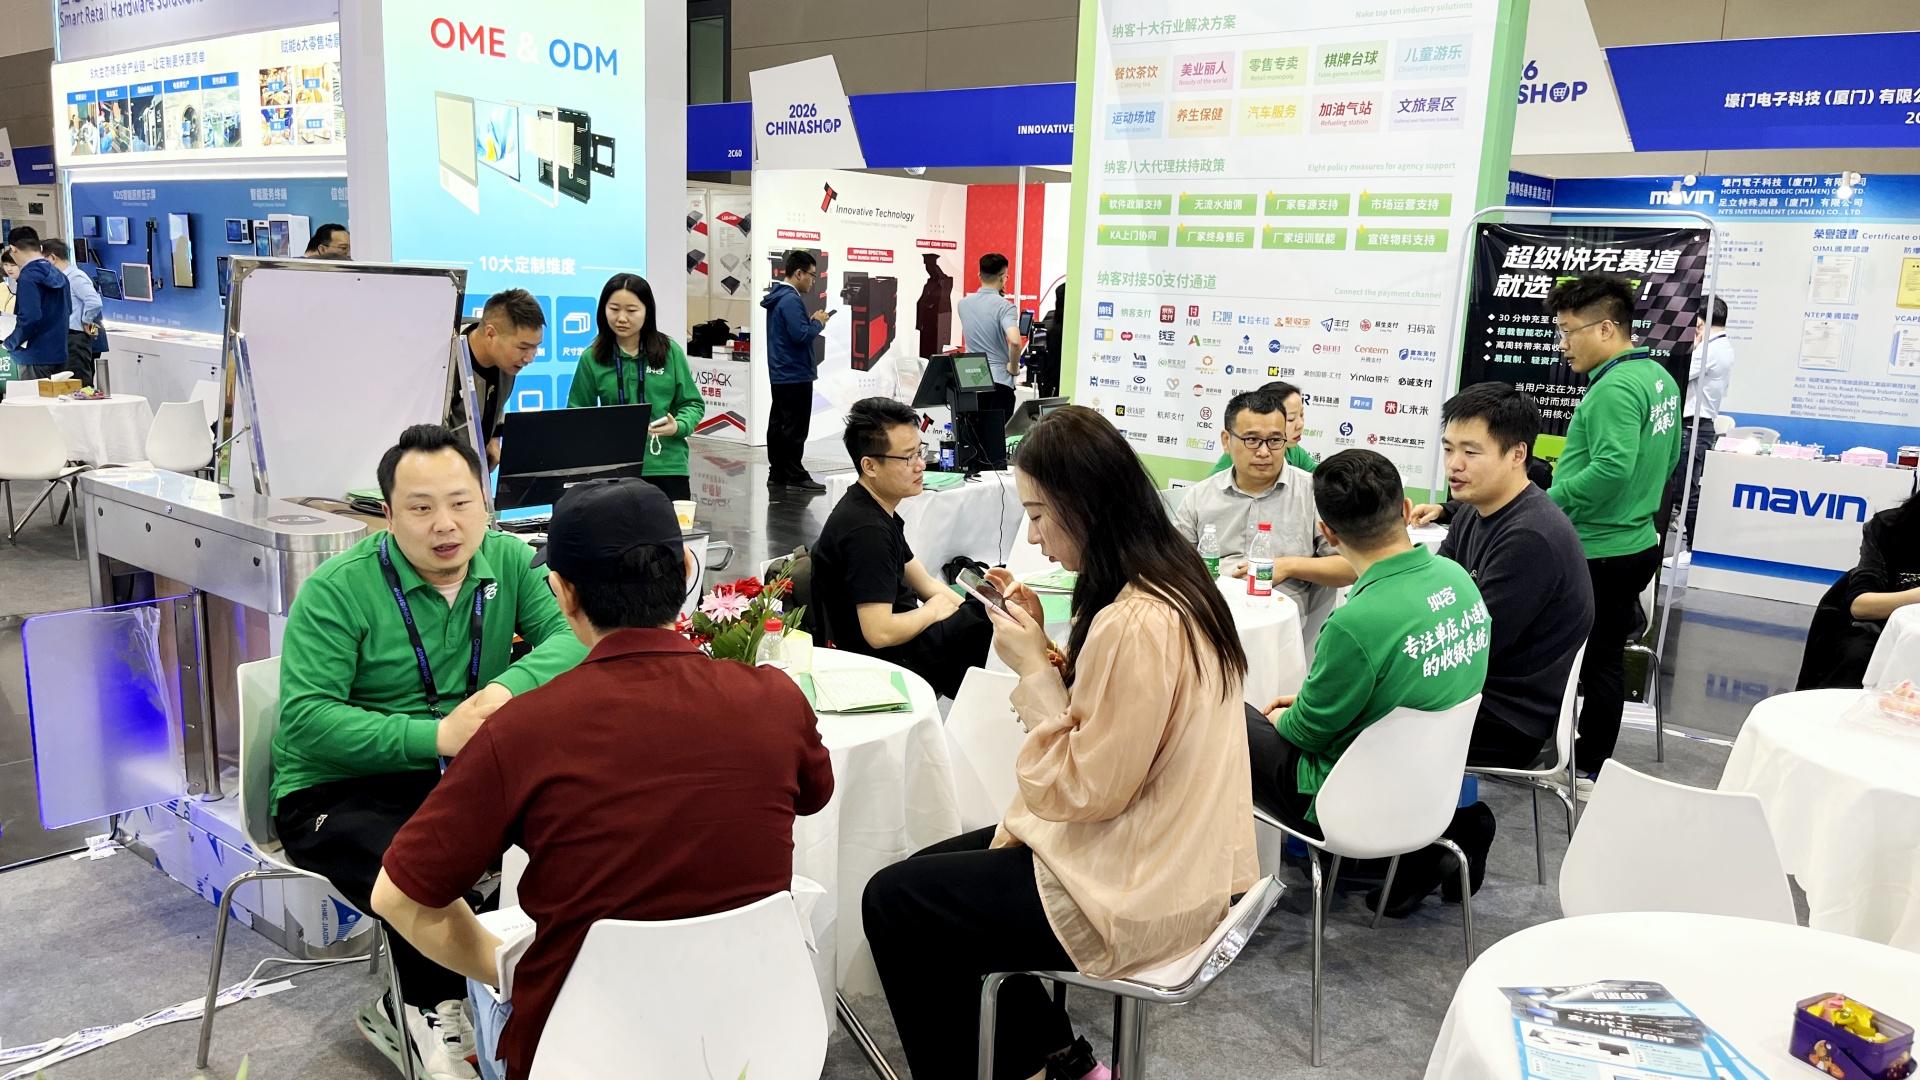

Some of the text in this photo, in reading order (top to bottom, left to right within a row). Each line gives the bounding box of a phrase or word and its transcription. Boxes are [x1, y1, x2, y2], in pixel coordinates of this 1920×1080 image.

[60, 9, 84, 28] Smart
[86, 3, 109, 23] Retail
[1403, 5, 1435, 15] industry
[1436, 2, 1473, 12] solutions
[1112, 14, 1237, 39] 纳客十大行业解决方案
[430, 17, 506, 58] OME
[549, 38, 618, 76] ODM
[1405, 45, 1463, 63] 儿童游乐
[1249, 56, 1298, 72] 零售专卖
[1324, 50, 1379, 68] 棋牌台球
[1114, 65, 1159, 81] 餐饮茶饮
[1180, 61, 1227, 77] 美业丽人
[788, 103, 817, 119] 2026
[1248, 105, 1297, 119] 汽车服务
[1319, 100, 1373, 117] 加油气站
[1397, 96, 1457, 114] 文旅景区
[1112, 111, 1156, 125] 运动场馆
[1176, 107, 1224, 122] 养生保健
[765, 118, 842, 136] CHINASHOP
[1017, 124, 1074, 135] INNOVATIVE
[728, 149, 742, 158] 2C60
[1104, 158, 1226, 174] 纳客八大代理扶持政策
[1307, 164, 1326, 173] Eight
[1327, 163, 1348, 172] policy
[1397, 163, 1424, 172] agency
[1425, 162, 1456, 170] support
[1371, 198, 1439, 211] 市场运营支持
[1649, 190, 1715, 206] mvin
[835, 204, 915, 222] Innovative Technology
[1734, 208, 1786, 216] INSTRUMENT
[796, 231, 820, 240] SPECTRAL
[1273, 232, 1336, 245] 厂家培训赋能
[1368, 233, 1436, 246] 宣传物料支持
[1862, 233, 1910, 241] Certificate
[479, 255, 577, 276] 10大定制维度
[1501, 244, 1683, 274] 超级快充赛道
[1097, 270, 1217, 290] 纳客对接50支付通道
[1334, 287, 1363, 296] Connect
[1411, 290, 1442, 298] channel
[1498, 314, 1550, 325] 30 分钟充至
[1407, 323, 1436, 335] 扫码富
[1354, 344, 1389, 355] Centerm
[1495, 340, 1565, 352] 高周转带来高收
[1650, 349, 1671, 357] 35%
[691, 370, 733, 387] ASPACK
[1398, 377, 1433, 388] 必诚支付
[701, 386, 722, 398] 乐思百
[1398, 404, 1429, 416] 汇米米
[1196, 421, 1213, 429] ICBC
[1732, 483, 1868, 523] mavin
[1426, 586, 1457, 613] 纳客
[1423, 626, 1489, 678] 的收银系统
